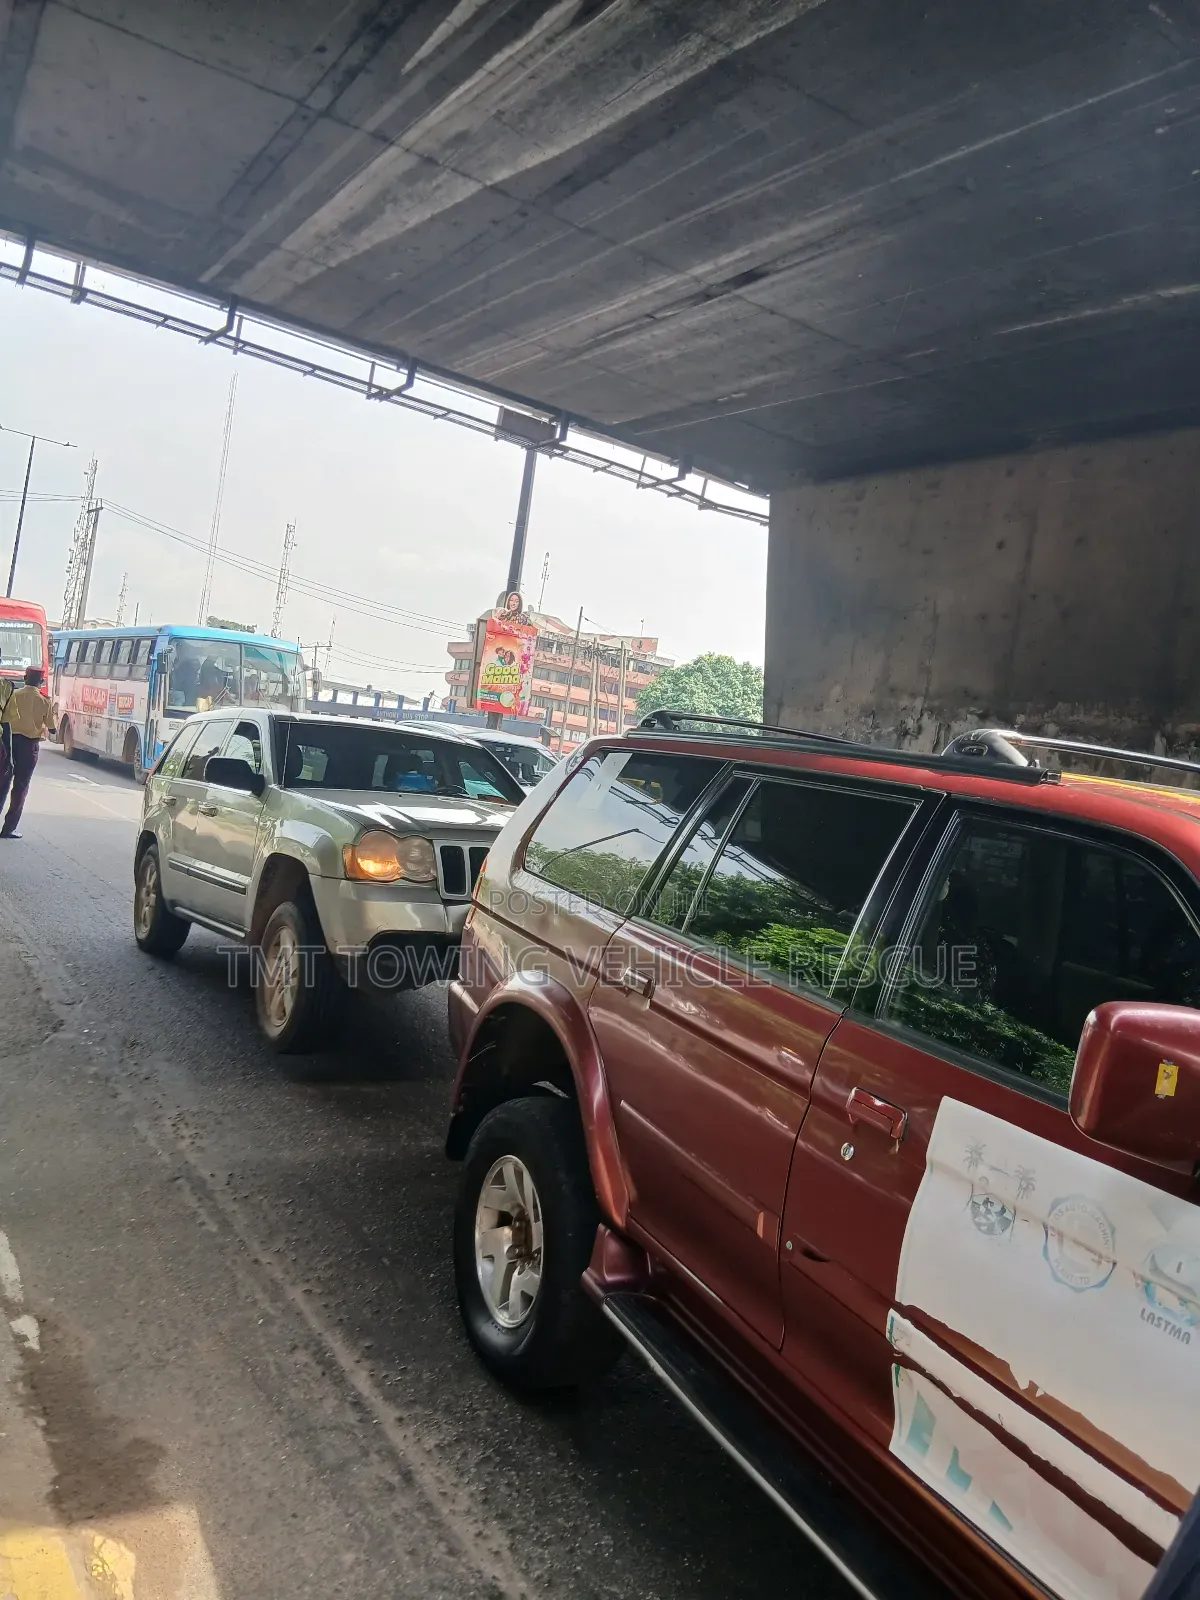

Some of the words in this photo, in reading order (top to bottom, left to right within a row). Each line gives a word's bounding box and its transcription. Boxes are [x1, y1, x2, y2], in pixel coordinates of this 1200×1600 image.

[486, 663, 520, 674] Good
[481, 674, 520, 684] Mama
[414, 713, 429, 721] STOP
[1140, 1307, 1191, 1345] LASTMA
